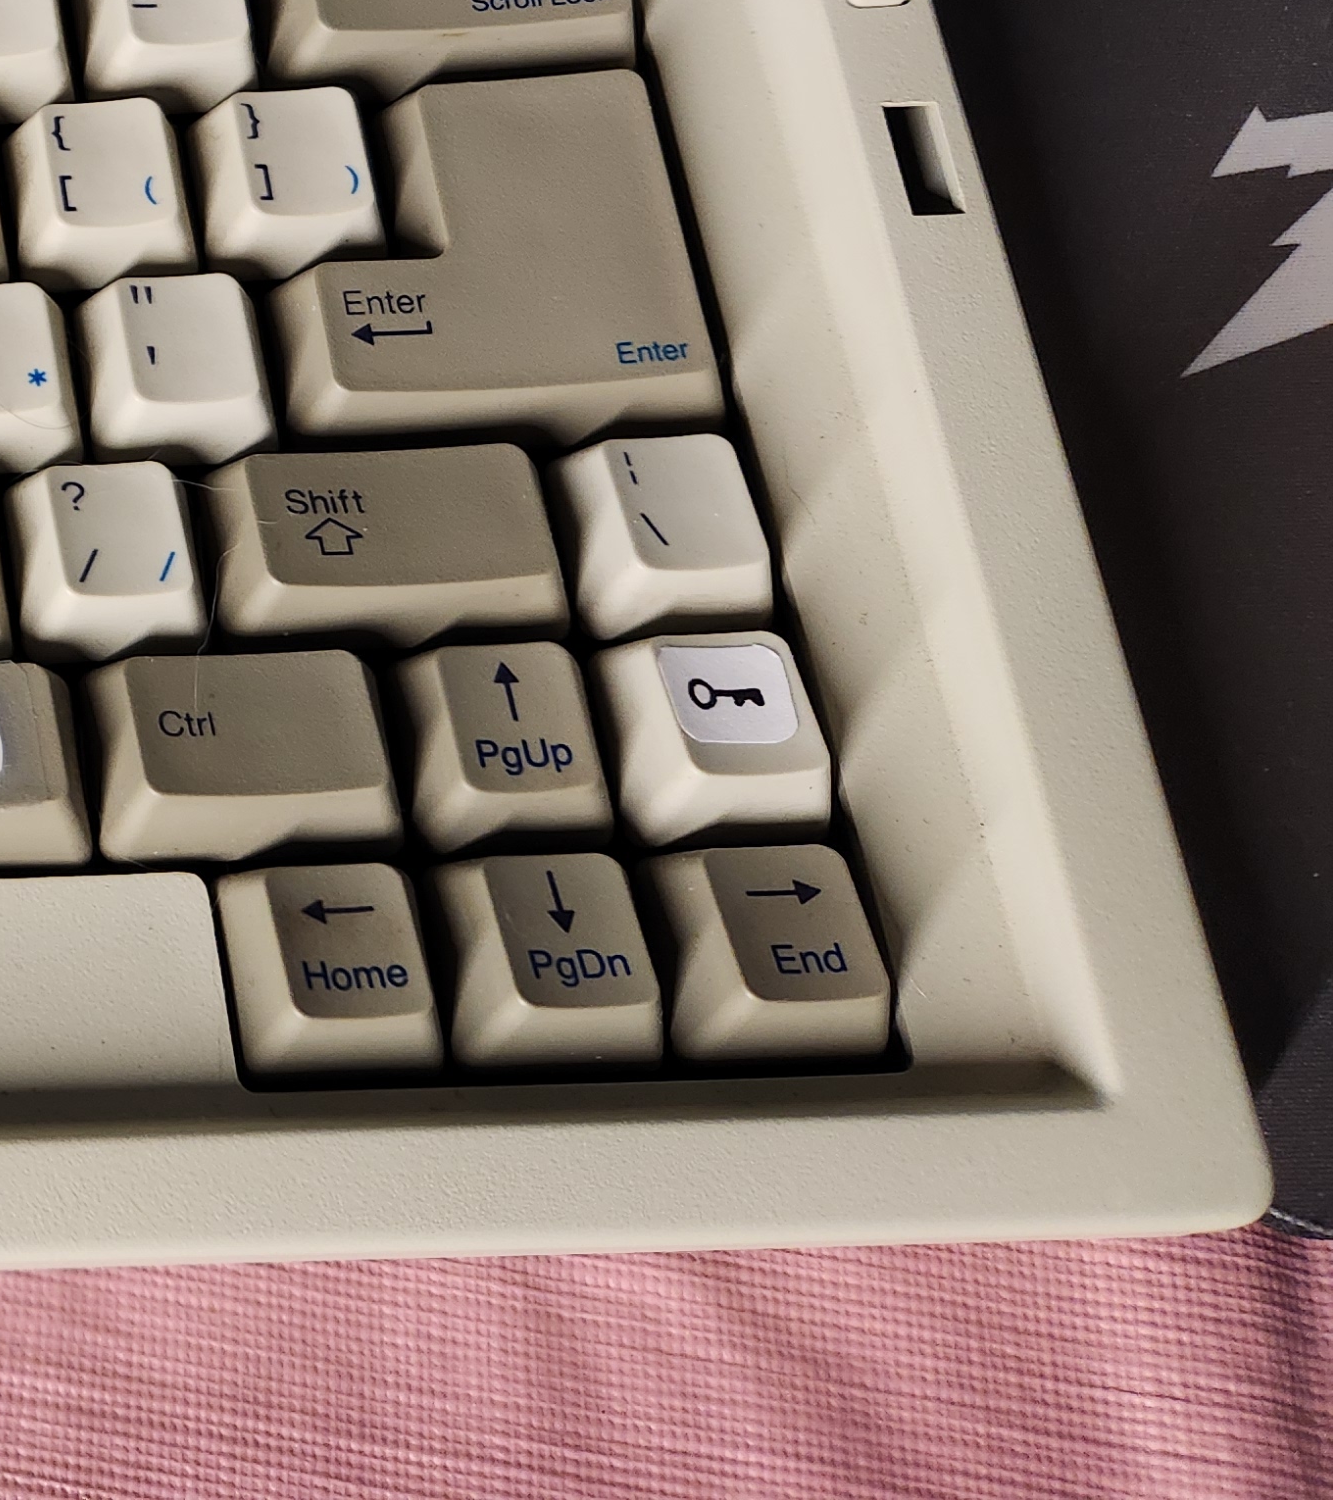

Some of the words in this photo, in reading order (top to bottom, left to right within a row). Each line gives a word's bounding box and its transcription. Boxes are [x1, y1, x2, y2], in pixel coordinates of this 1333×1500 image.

[343, 290, 426, 316] Enter
[616, 340, 688, 365] Enter
[285, 489, 365, 515] Shift
[158, 711, 216, 737] Ctrl
[475, 738, 573, 776] PgUp
[528, 949, 631, 988] PgDn
[771, 944, 848, 976] End
[303, 961, 409, 991] Home
